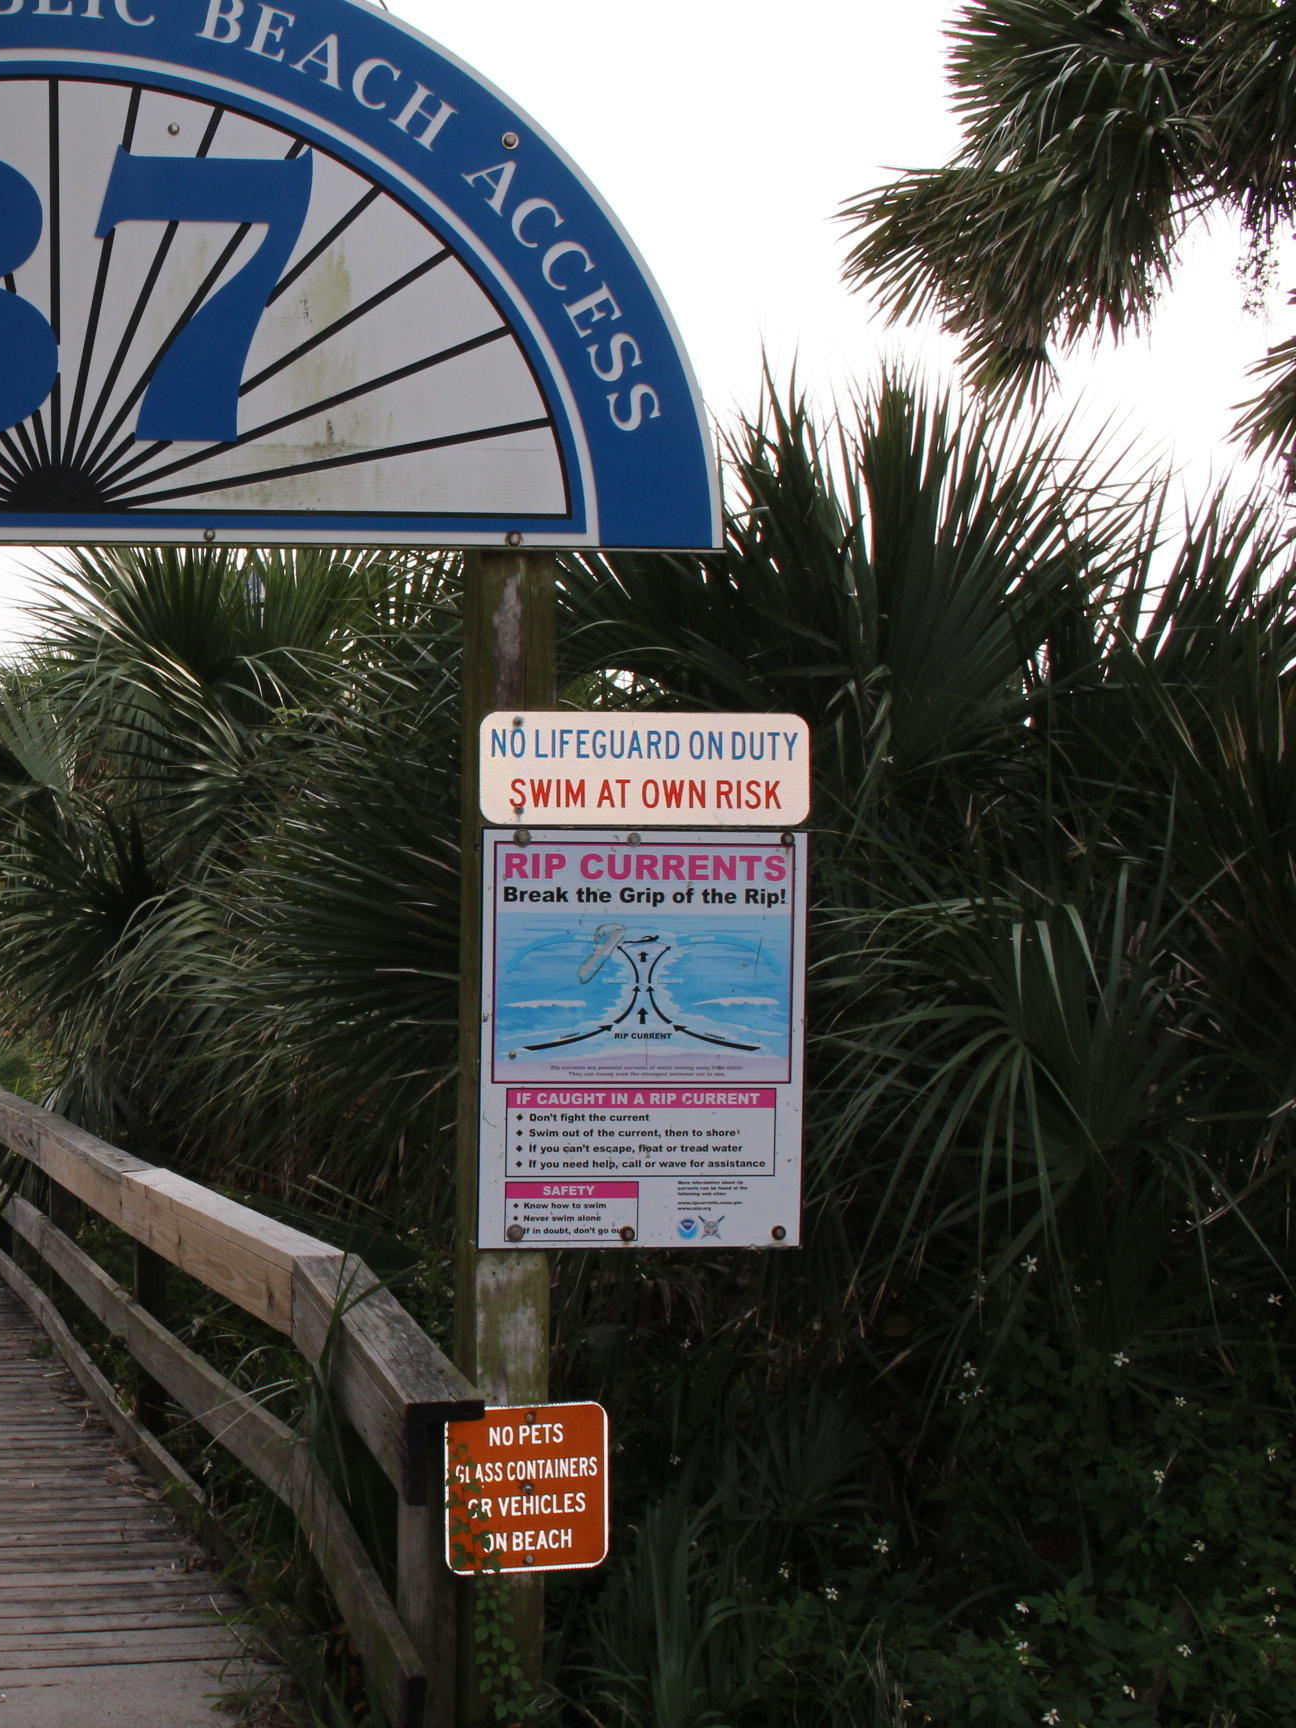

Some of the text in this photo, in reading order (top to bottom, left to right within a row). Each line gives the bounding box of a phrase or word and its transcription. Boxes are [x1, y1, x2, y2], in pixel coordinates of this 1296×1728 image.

[195, 0, 458, 151] BEACH
[461, 160, 662, 432] ACCESS
[491, 729, 798, 760] NO LIFEGUARD ON DUTY
[510, 779, 781, 809] SWIM AT OWN RISK
[504, 853, 786, 881] RIP CURRENTS
[504, 886, 785, 908] Break the Grip of the Rip!
[517, 1093, 760, 1105] IF CAUGHT IN A RIP CURRENT
[530, 1114, 557, 1122] Don't
[561, 1114, 585, 1123] fight
[589, 1113, 606, 1121] the
[529, 1129, 558, 1137] Swim
[583, 1129, 593, 1137] of
[598, 1129, 615, 1137] the
[618, 1130, 661, 1138] current,
[529, 1144, 537, 1152] If
[563, 1144, 589, 1152] can't
[593, 1146, 635, 1154] escape,
[639, 1144, 663, 1152] float
[681, 1144, 708, 1152] tread
[529, 1160, 536, 1168] If
[540, 1162, 559, 1170] you
[563, 1160, 589, 1168] need
[593, 1160, 618, 1169] help,
[543, 1186, 595, 1196] SAFETY
[543, 1227, 571, 1235] doubt,
[488, 1423, 564, 1446] NO PETS
[456, 1456, 597, 1483] GLASS CONTAINERS
[468, 1492, 586, 1519] OR VEHICLES
[483, 1528, 572, 1552] ON BEACH
